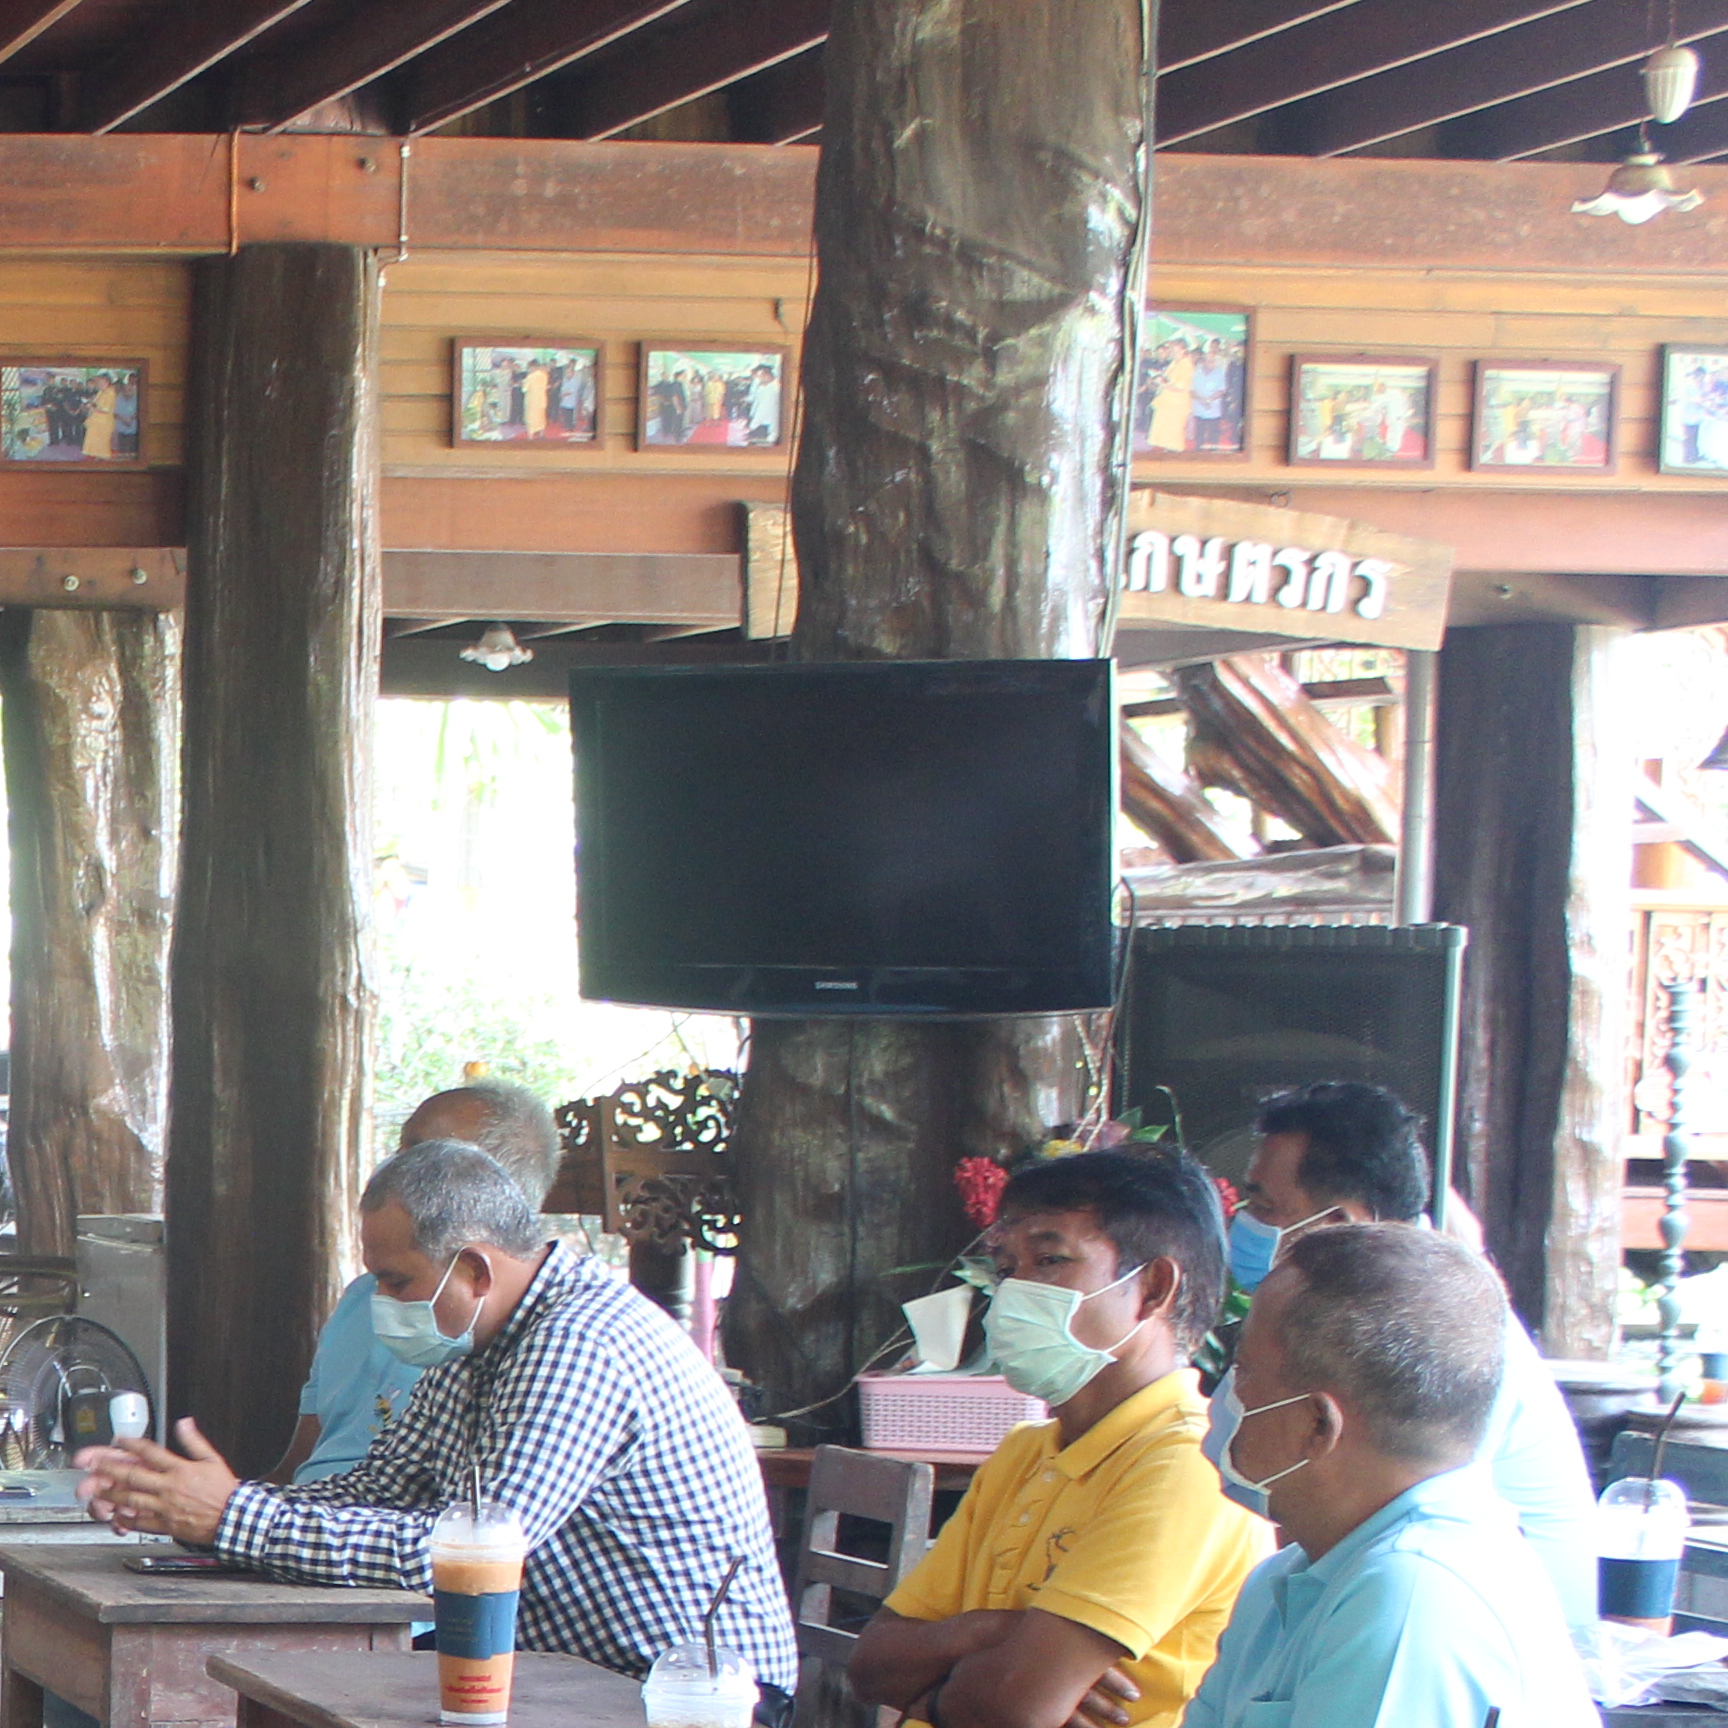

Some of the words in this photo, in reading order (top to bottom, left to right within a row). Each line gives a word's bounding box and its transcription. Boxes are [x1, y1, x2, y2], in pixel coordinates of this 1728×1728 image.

[1120, 530, 1394, 620] กษตรกร
[814, 982, 858, 990] SAMSUNG
